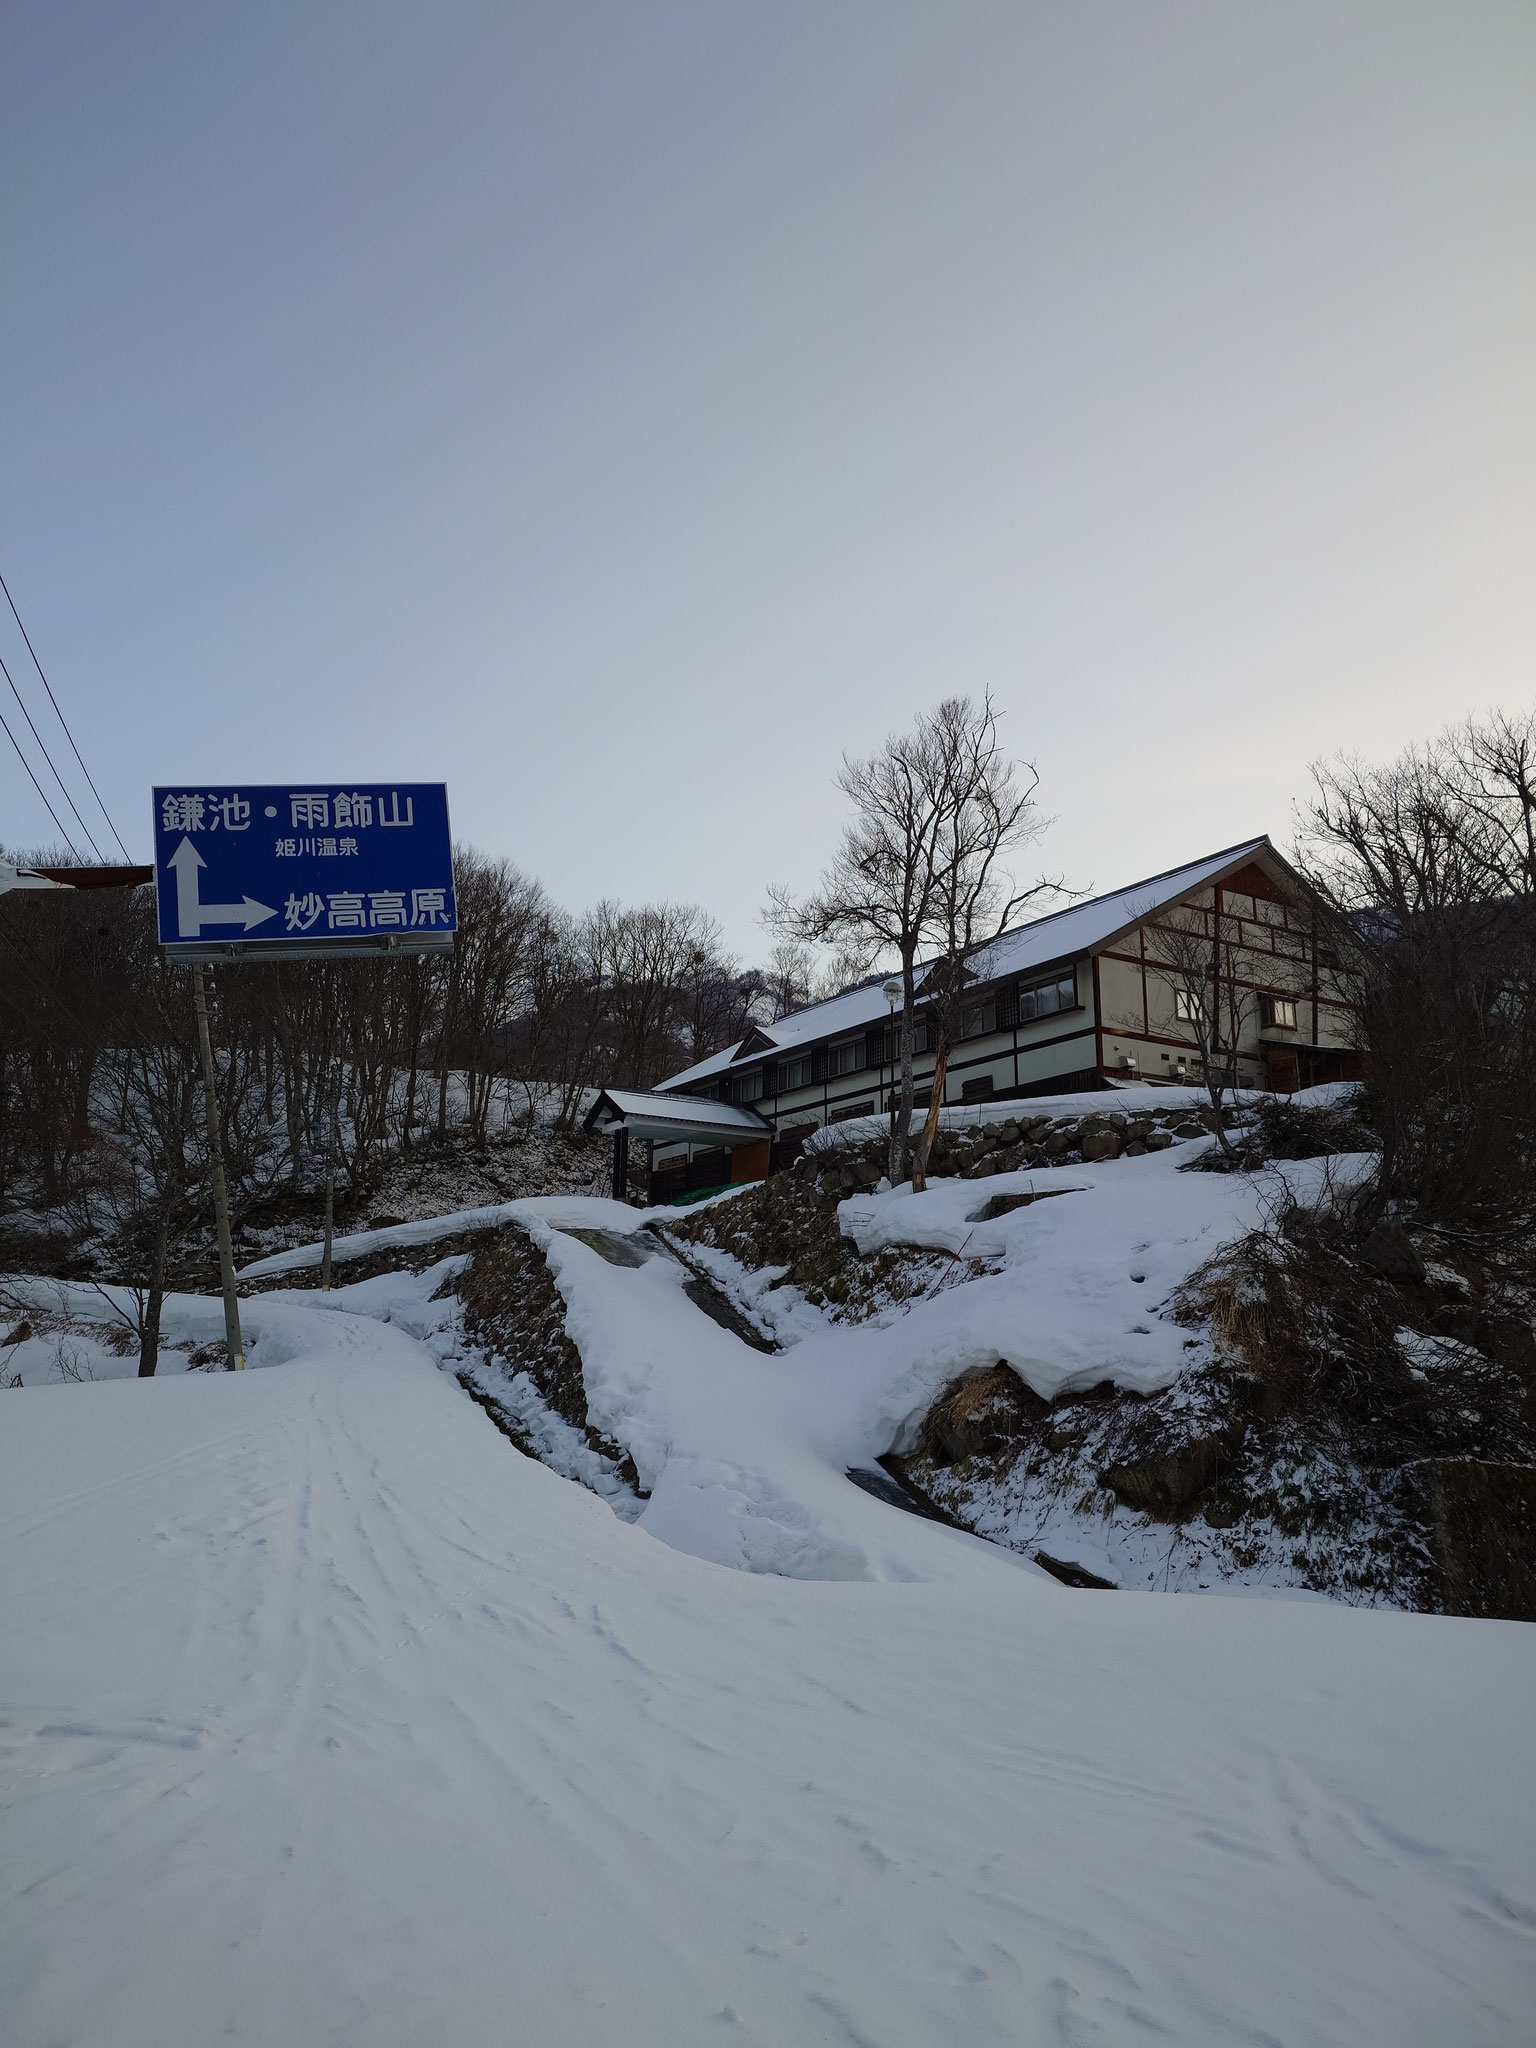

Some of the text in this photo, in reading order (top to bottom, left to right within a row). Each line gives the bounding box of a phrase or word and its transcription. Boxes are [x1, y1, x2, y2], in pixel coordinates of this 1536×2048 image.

[275, 836, 359, 858] 姫川温泉
[284, 889, 449, 931] 妙高高原
